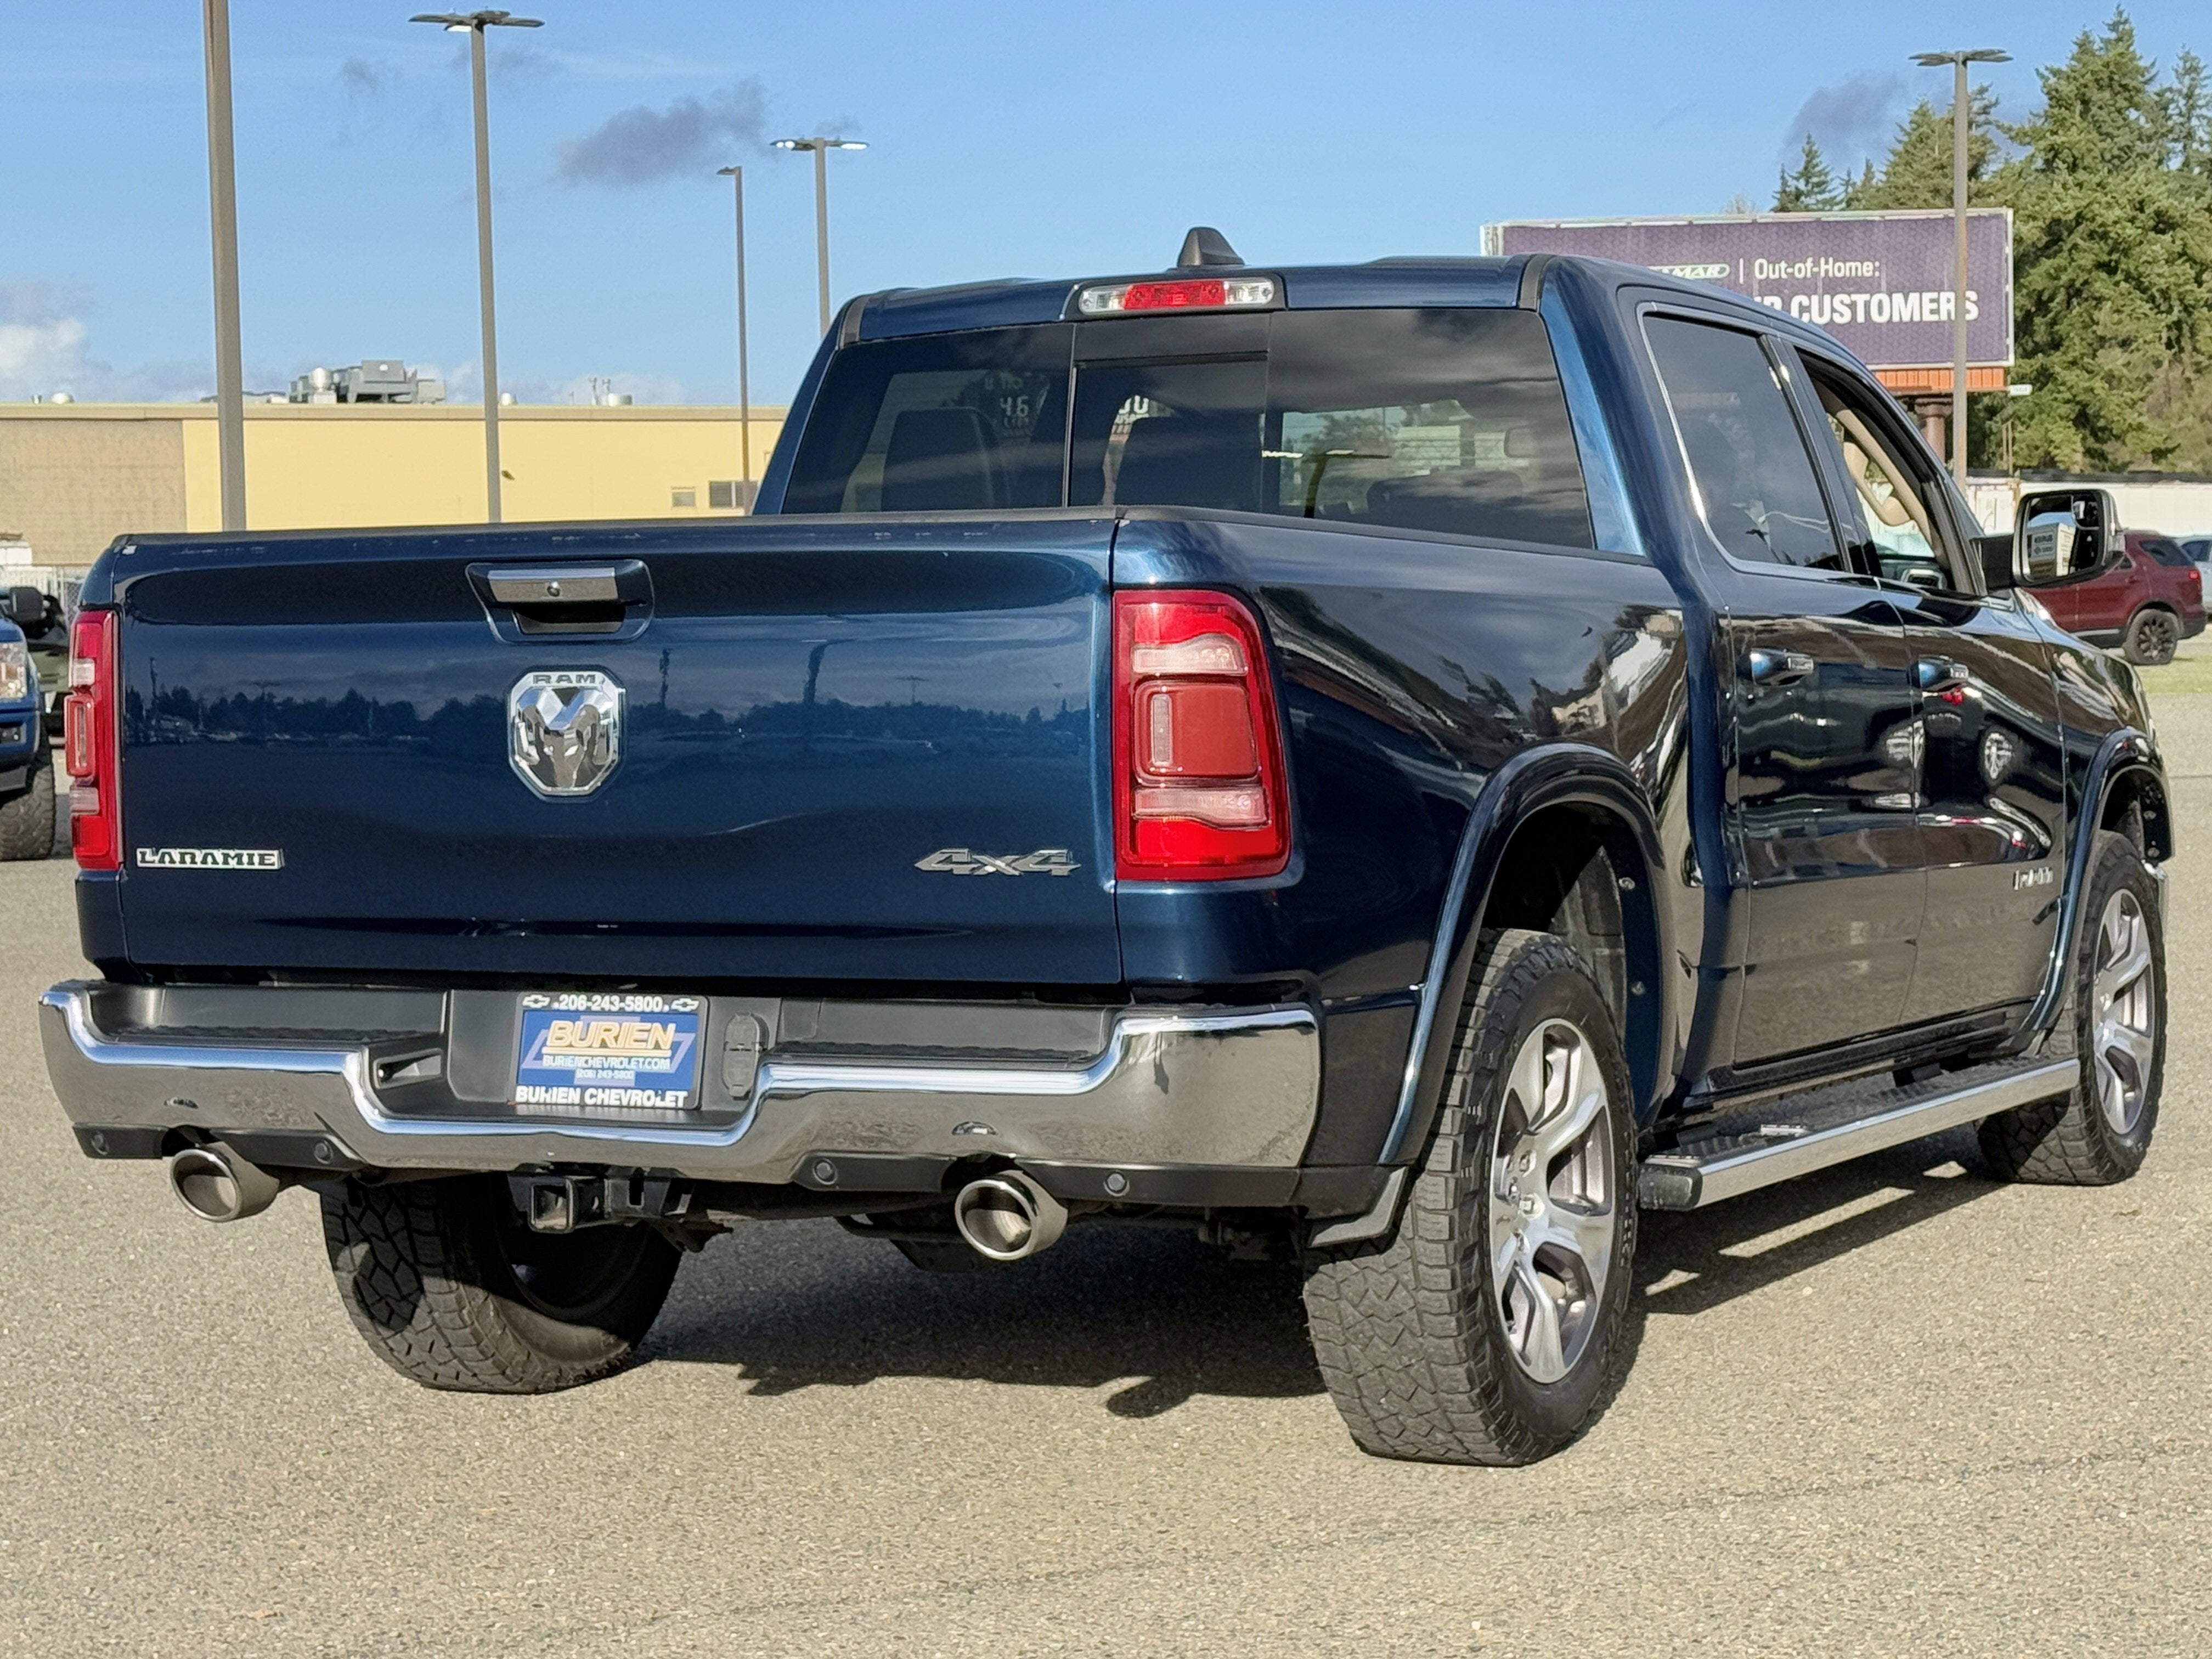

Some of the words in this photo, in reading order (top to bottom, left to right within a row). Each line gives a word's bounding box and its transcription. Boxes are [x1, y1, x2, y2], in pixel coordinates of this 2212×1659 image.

[1754, 257, 1881, 279] Out-of-Home:
[1790, 291, 1979, 324] CUSTOMERS
[533, 674, 596, 685] RAM
[137, 849, 279, 868] LARAMIE
[558, 994, 663, 1012] 206-243-5800
[545, 1020, 676, 1050] BURIEN
